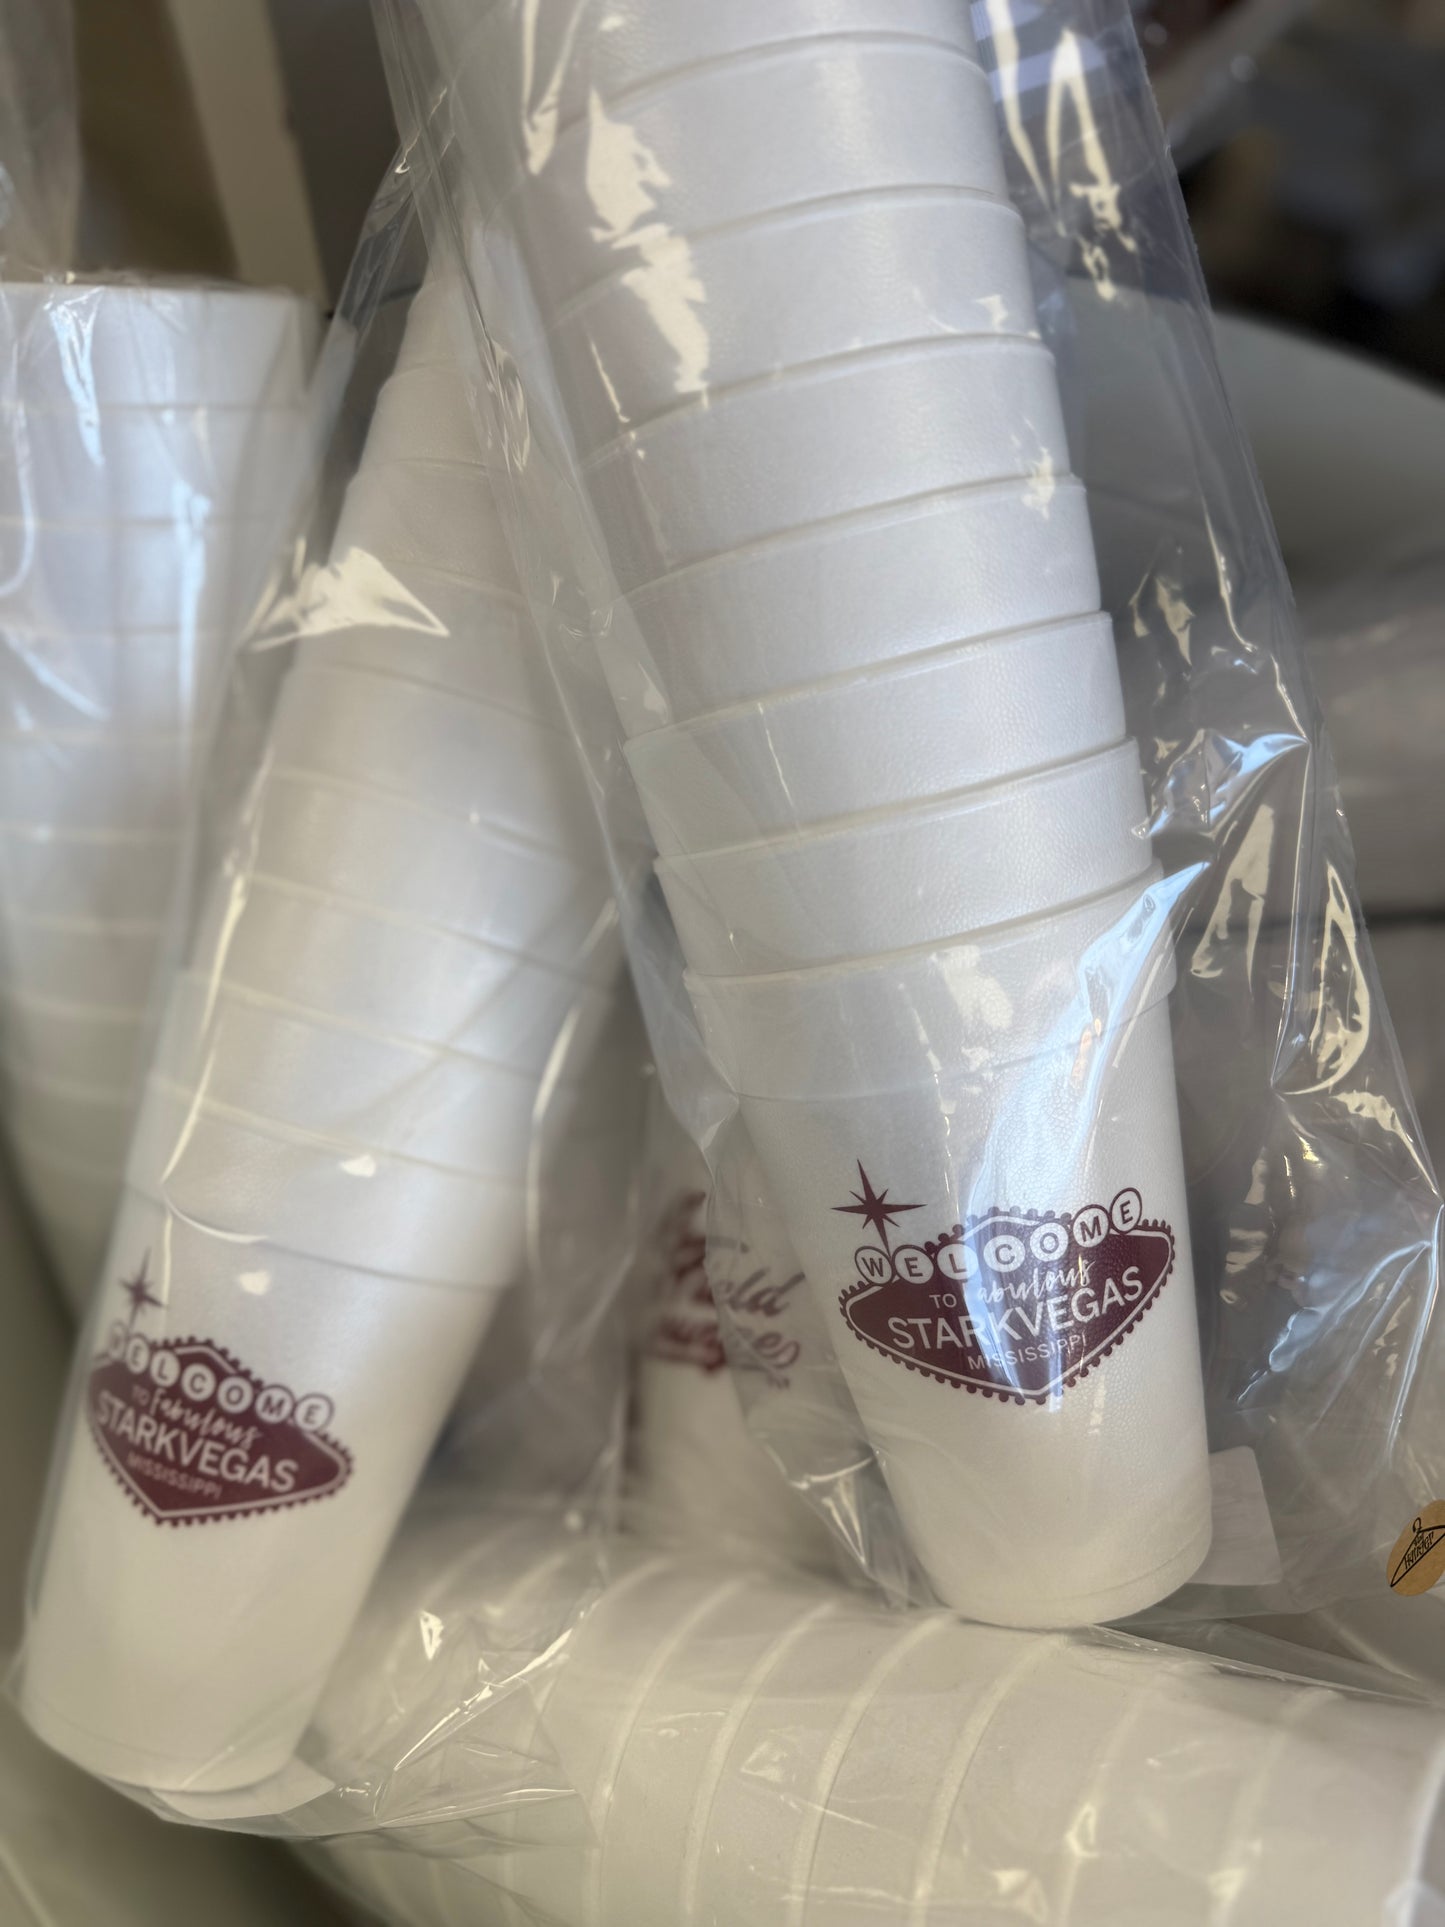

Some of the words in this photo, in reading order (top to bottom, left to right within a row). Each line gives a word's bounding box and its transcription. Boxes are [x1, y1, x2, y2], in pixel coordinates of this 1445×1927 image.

[855, 1188, 1142, 1284] WELCOME
[888, 1266, 1143, 1350] STARKVEGAS
[929, 1294, 957, 1309] TO
[964, 1259, 1096, 1304] abulous
[108, 1322, 334, 1433] ELCOME
[967, 1334, 1088, 1371] MISSISSIPPI
[98, 1391, 298, 1492] STARKVEGAS
[126, 1450, 223, 1500] MISSISSIPPI
